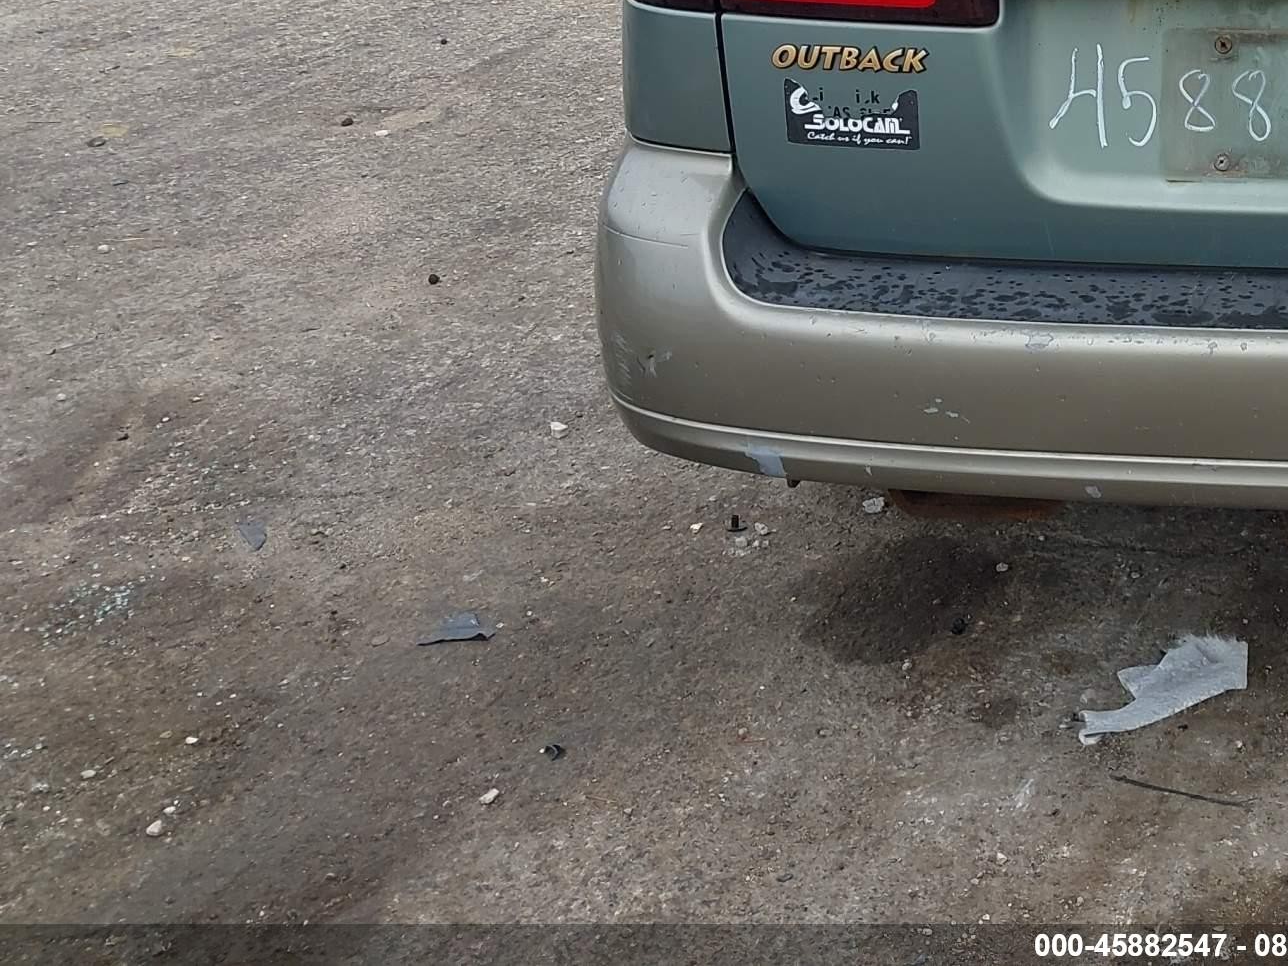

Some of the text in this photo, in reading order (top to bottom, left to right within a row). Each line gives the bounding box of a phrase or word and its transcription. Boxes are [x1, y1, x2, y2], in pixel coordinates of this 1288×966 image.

[771, 43, 930, 74] OUTBACK
[805, 114, 910, 134] SOLOCAM
[807, 132, 835, 141] Catch
[851, 134, 862, 145] if
[863, 137, 884, 145] you
[885, 137, 909, 145] can!
